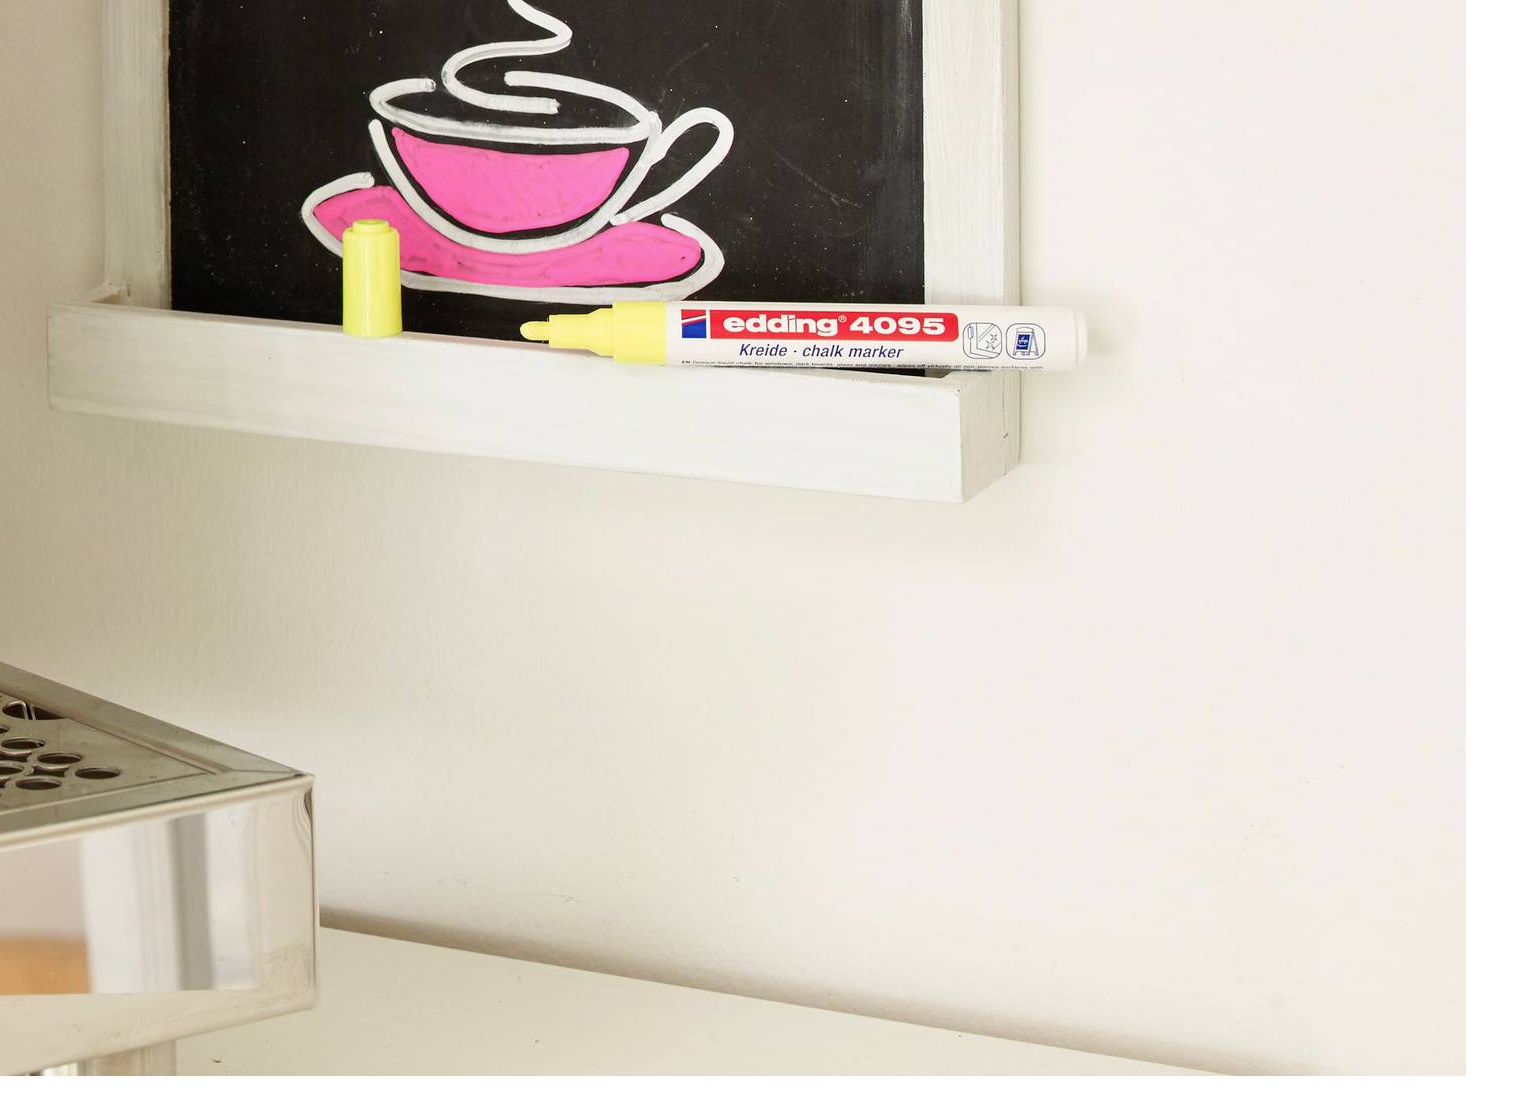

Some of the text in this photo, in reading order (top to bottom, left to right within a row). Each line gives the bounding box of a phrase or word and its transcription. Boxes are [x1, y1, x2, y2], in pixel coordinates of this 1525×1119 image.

[849, 316, 946, 335] 4095
[739, 343, 904, 359] Kreide chalk marker
